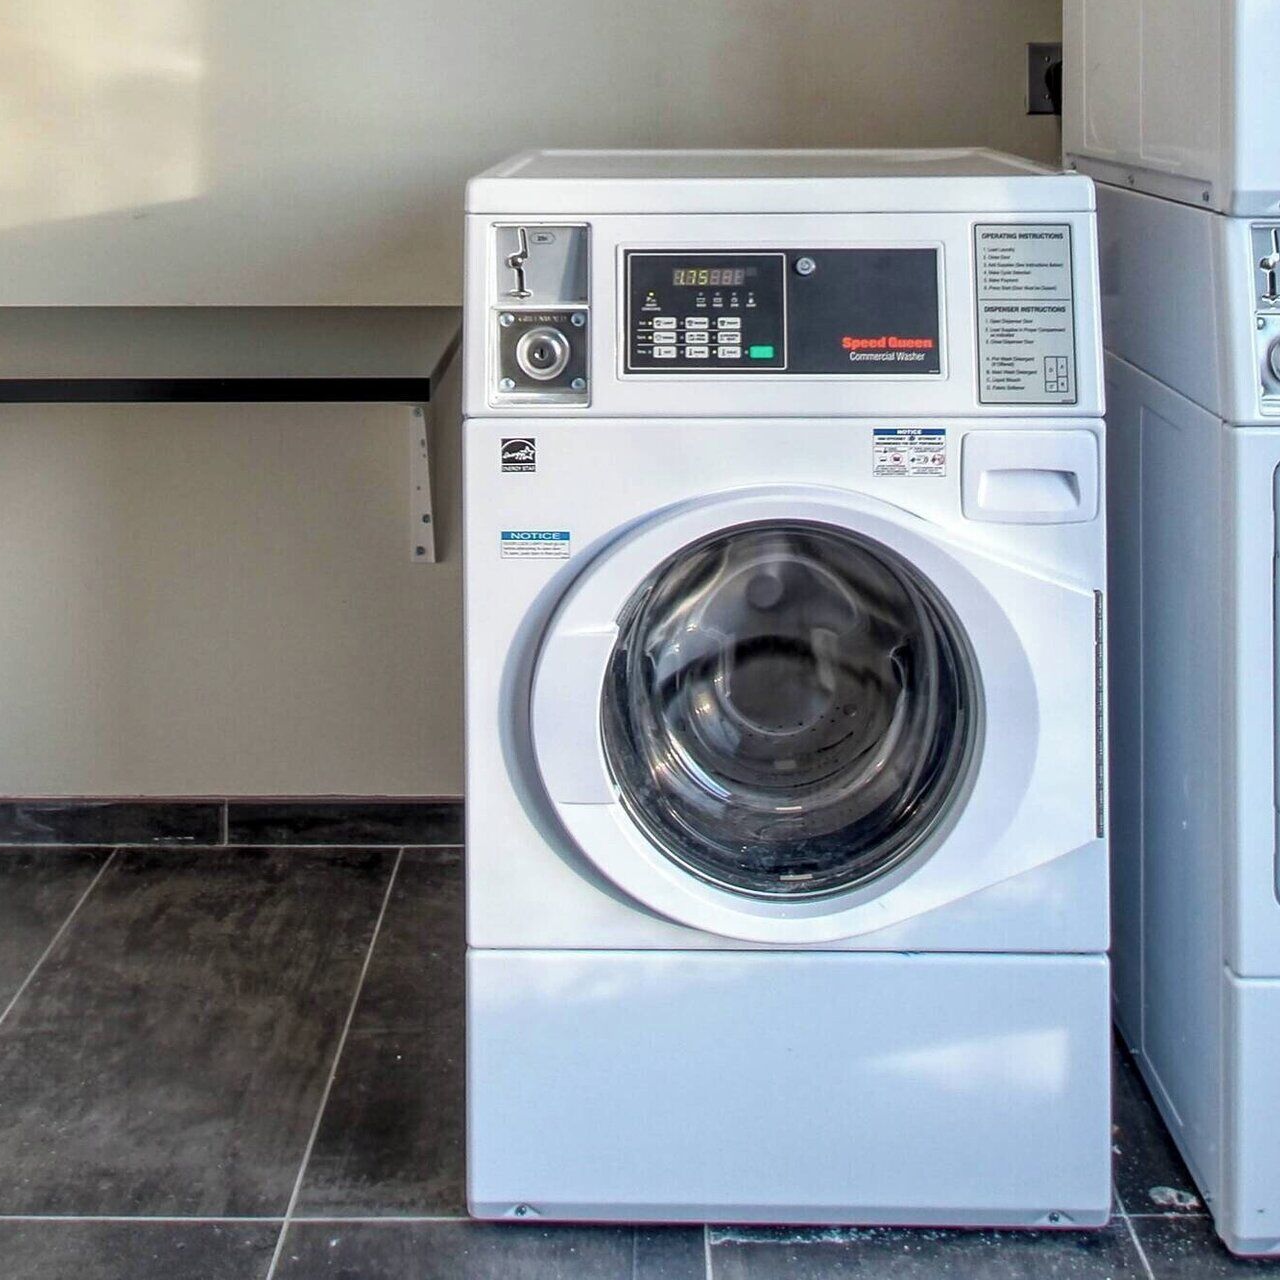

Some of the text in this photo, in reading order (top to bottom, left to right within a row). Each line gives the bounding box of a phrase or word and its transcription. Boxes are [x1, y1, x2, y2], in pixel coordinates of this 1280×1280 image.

[1018, 232, 1064, 240] INSTRUCTIONS
[841, 337, 933, 350] Speed Queen
[849, 351, 926, 361] Commercial Washer
[510, 532, 561, 540] NOTICE
